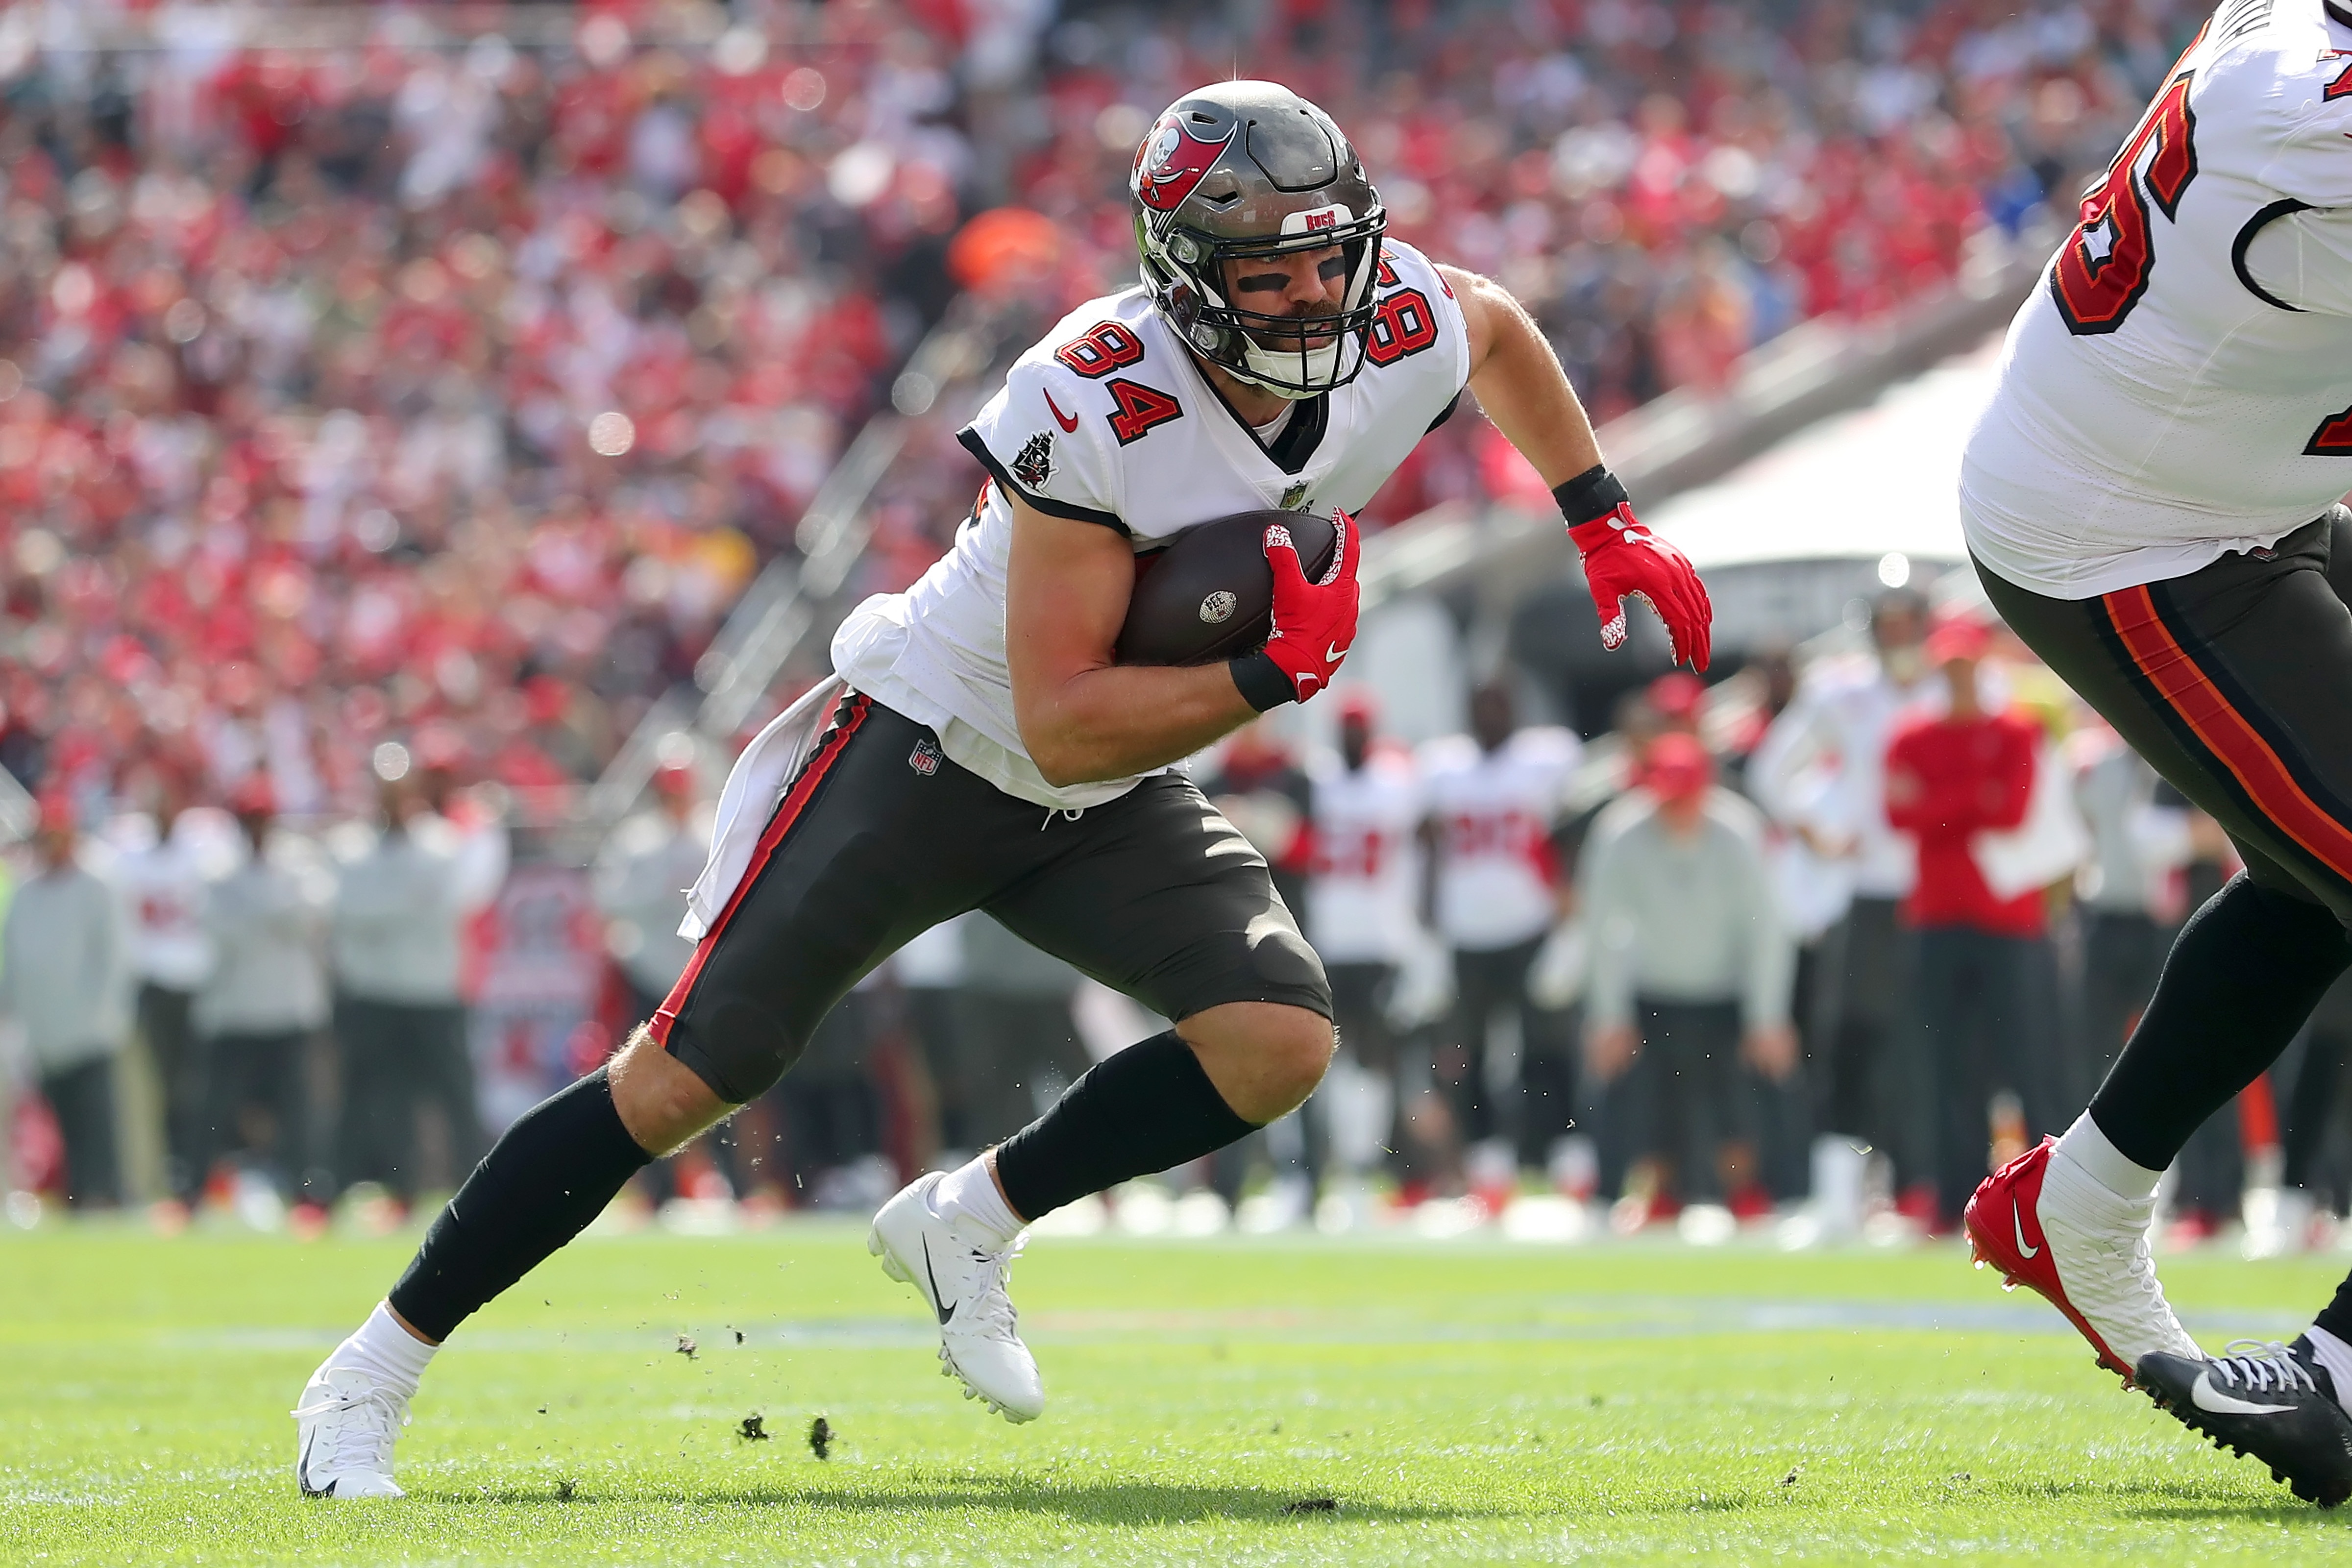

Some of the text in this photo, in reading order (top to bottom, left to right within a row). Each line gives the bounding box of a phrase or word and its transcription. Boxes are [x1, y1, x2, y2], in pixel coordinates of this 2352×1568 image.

[2051, 18, 2212, 336] 6
[1054, 320, 1184, 447] 84
[914, 753, 933, 771] NFL
